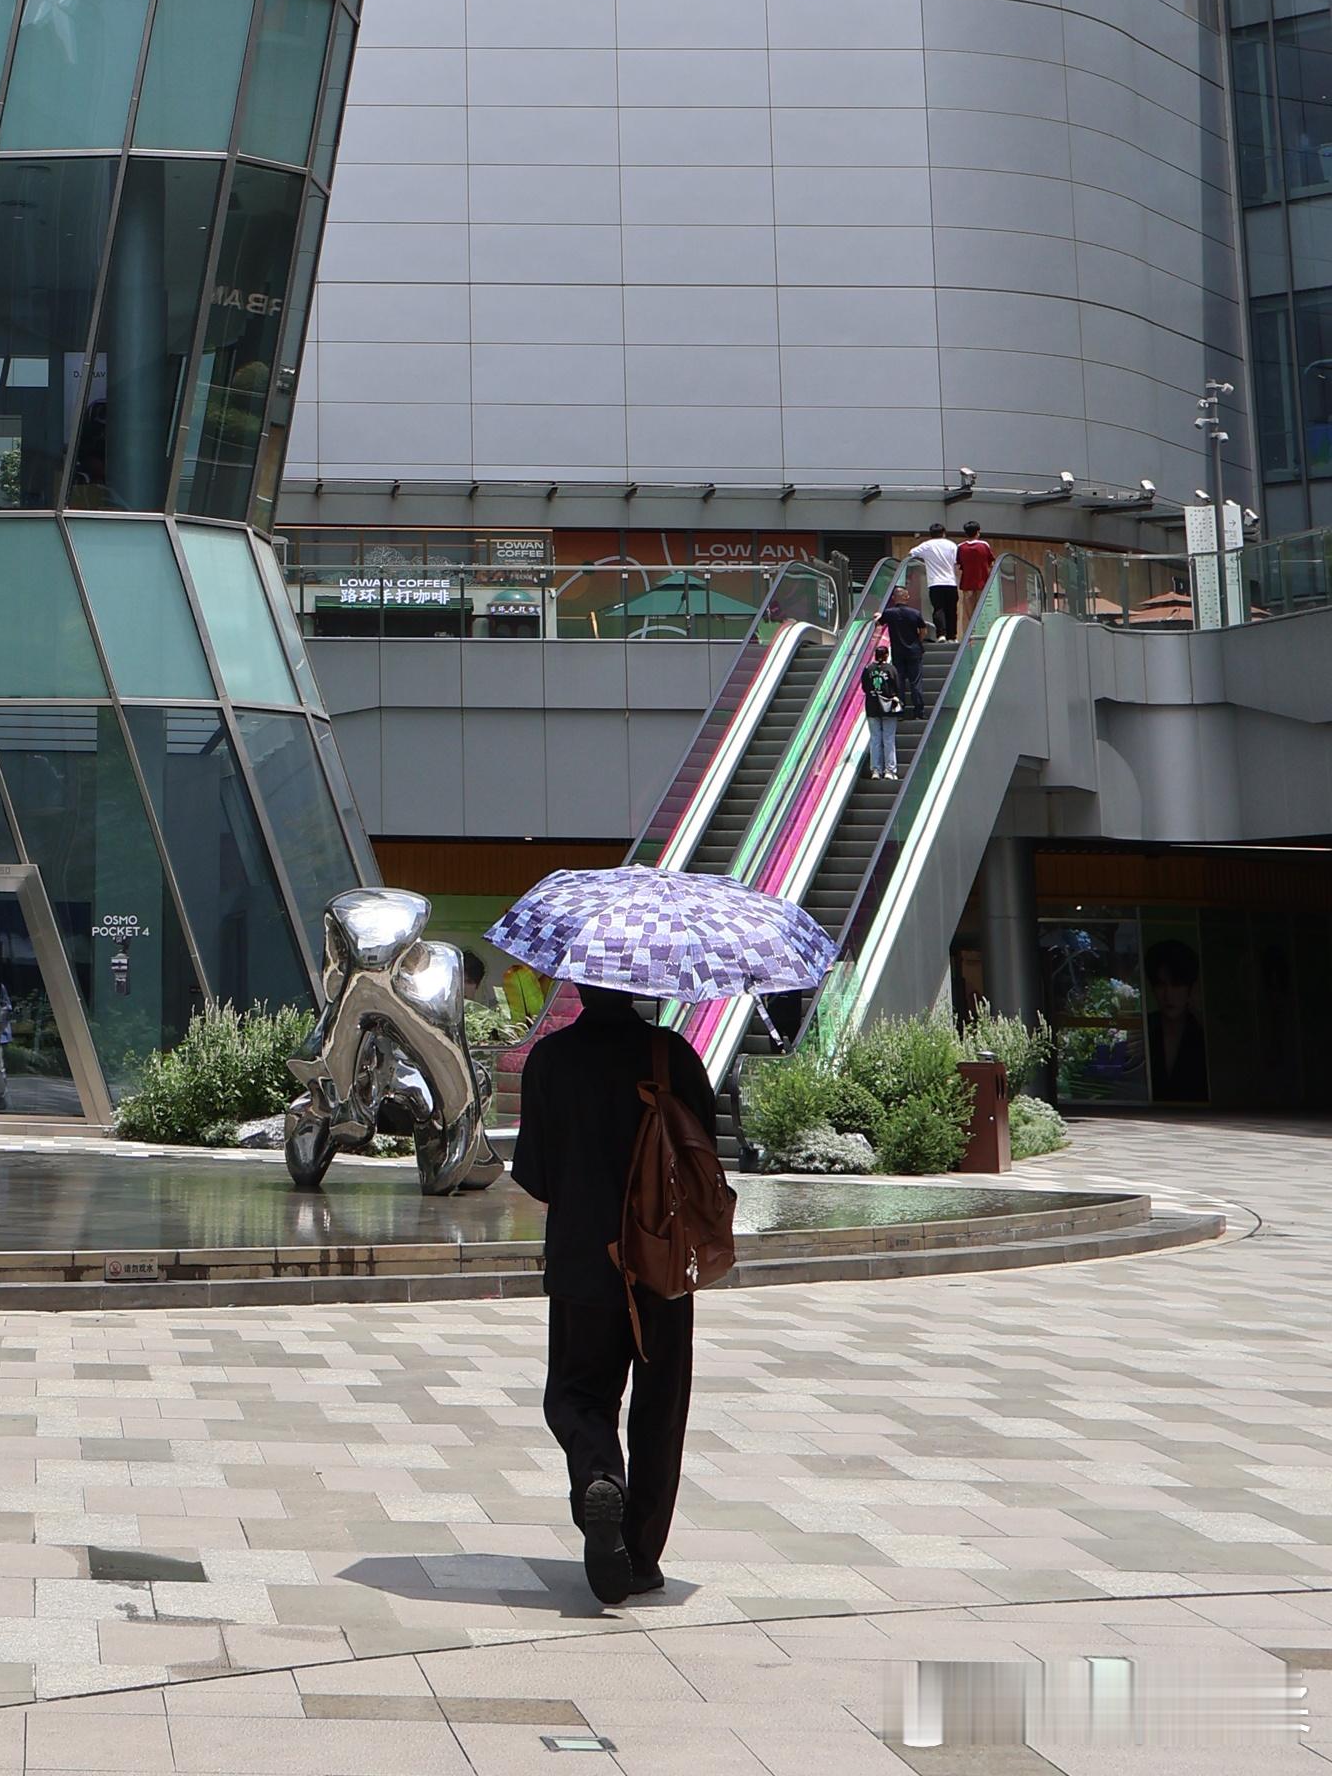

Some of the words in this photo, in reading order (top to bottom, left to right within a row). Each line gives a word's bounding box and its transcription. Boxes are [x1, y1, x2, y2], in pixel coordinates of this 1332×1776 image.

[694, 543, 795, 558] LOWAN
[339, 578, 393, 588] LOWAN
[397, 579, 451, 588] COFFEE
[340, 588, 451, 605] 路环手打咖啡
[103, 915, 138, 925] OSMO
[92, 927, 140, 937] POCKET
[142, 927, 149, 937] 4
